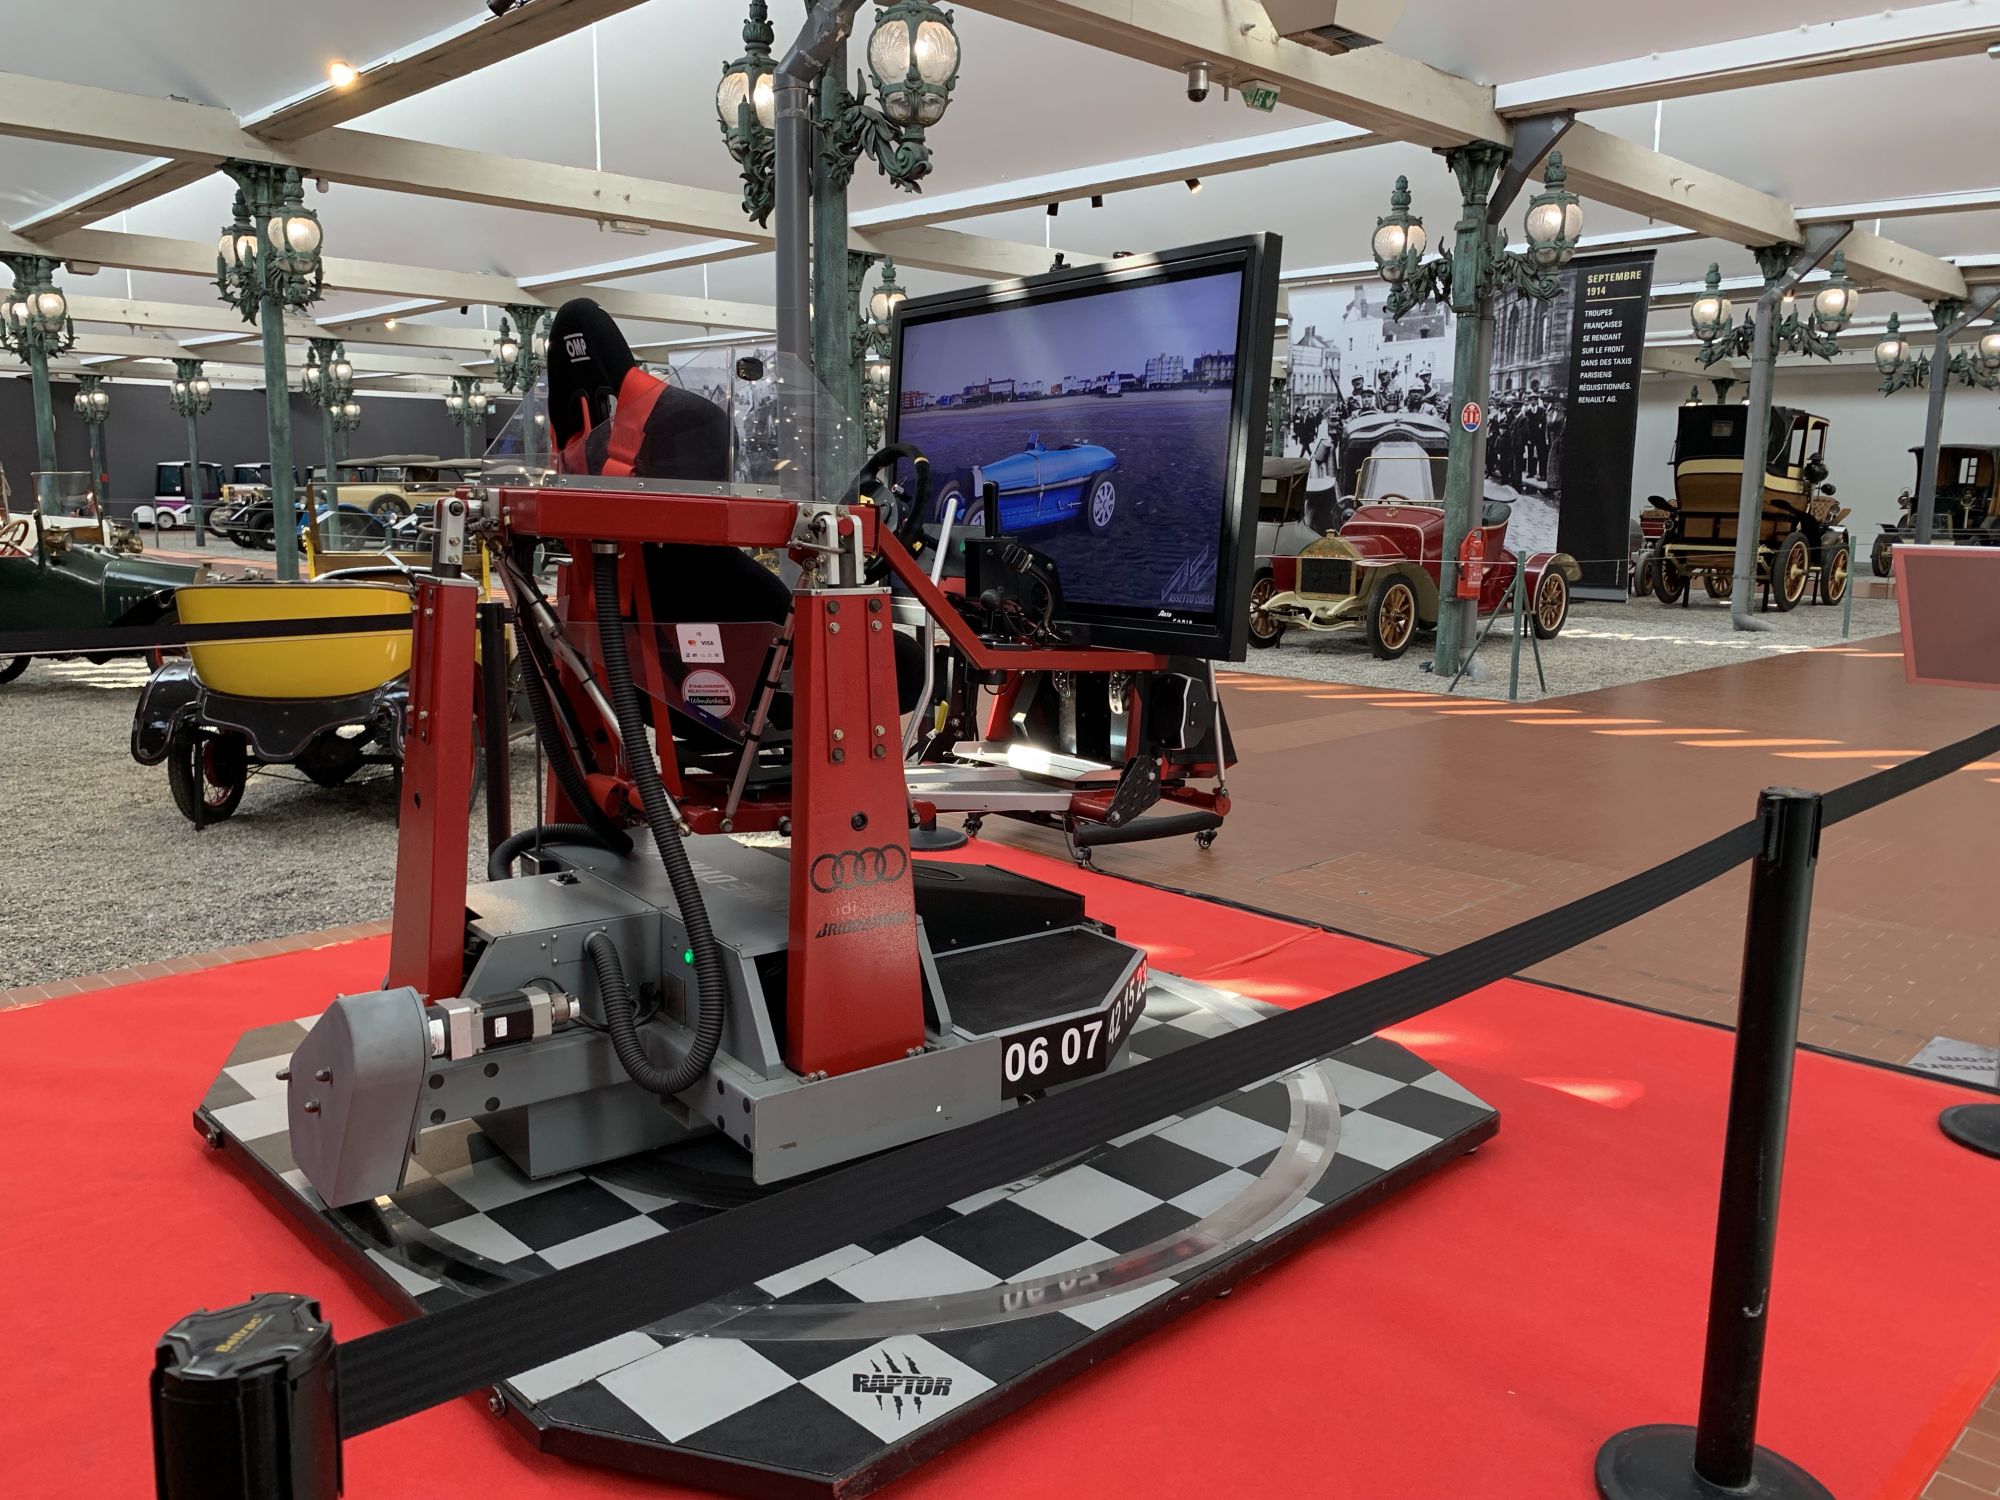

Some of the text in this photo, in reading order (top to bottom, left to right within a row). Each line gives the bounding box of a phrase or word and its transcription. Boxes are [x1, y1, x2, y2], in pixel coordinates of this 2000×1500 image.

[1587, 270, 1642, 284] SEPTEMBRE
[1586, 286, 1607, 297] 1914
[1584, 308, 1613, 317] TROUPES
[1583, 320, 1623, 330] FRANÇAISES
[1591, 332, 1622, 341] RENDANT
[565, 338, 587, 358] OMP
[1581, 345, 1625, 355] SUR LE FRONT
[1580, 357, 1632, 367] DANS DES TAXIS
[1579, 371, 1612, 379] PARISIENS
[1578, 382, 1632, 392] RÉQUISITIONNÉS.
[1577, 396, 1606, 404] RENAULT
[1005, 959, 1148, 1082] 06 07 42 15 23
[852, 1373, 953, 1396] RAPTOR
